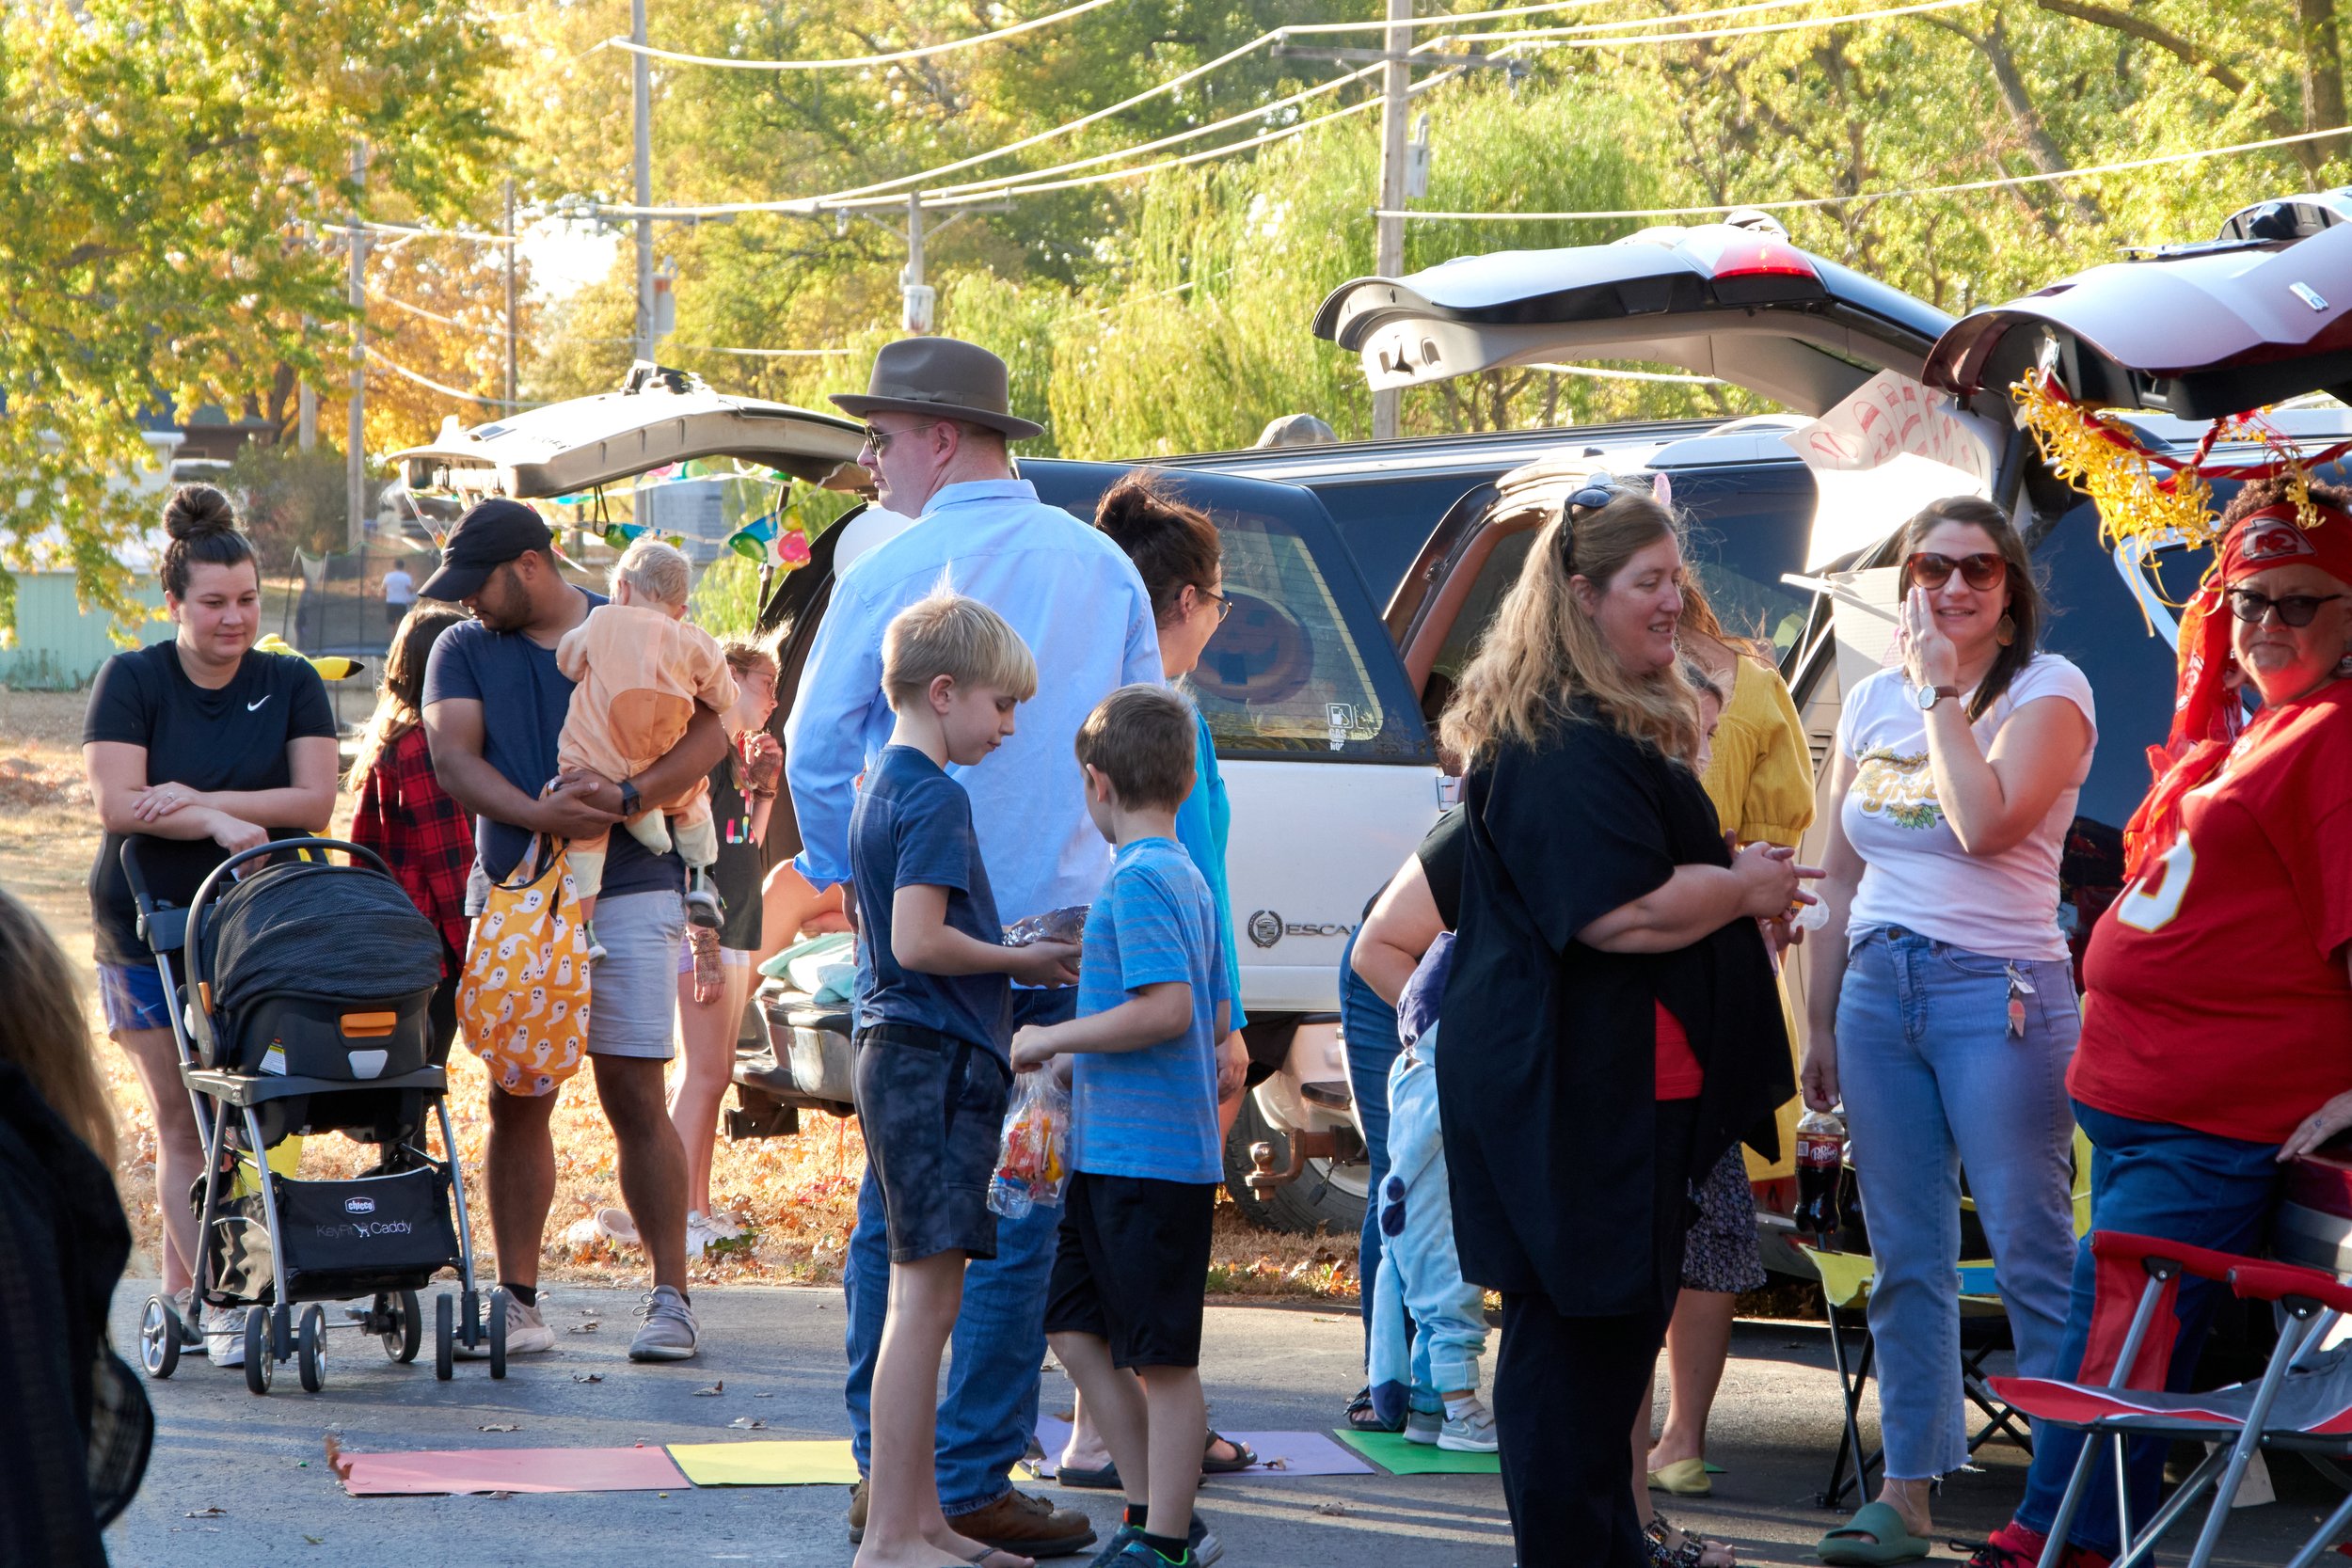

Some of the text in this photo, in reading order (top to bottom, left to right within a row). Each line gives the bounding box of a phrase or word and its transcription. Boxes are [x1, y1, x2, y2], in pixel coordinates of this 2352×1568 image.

[1328, 728, 1347, 741] GAS
[1285, 923, 1358, 937] ESCA
[348, 1200, 373, 1211] chicco
[316, 1220, 413, 1239] KeyFit Caddy
